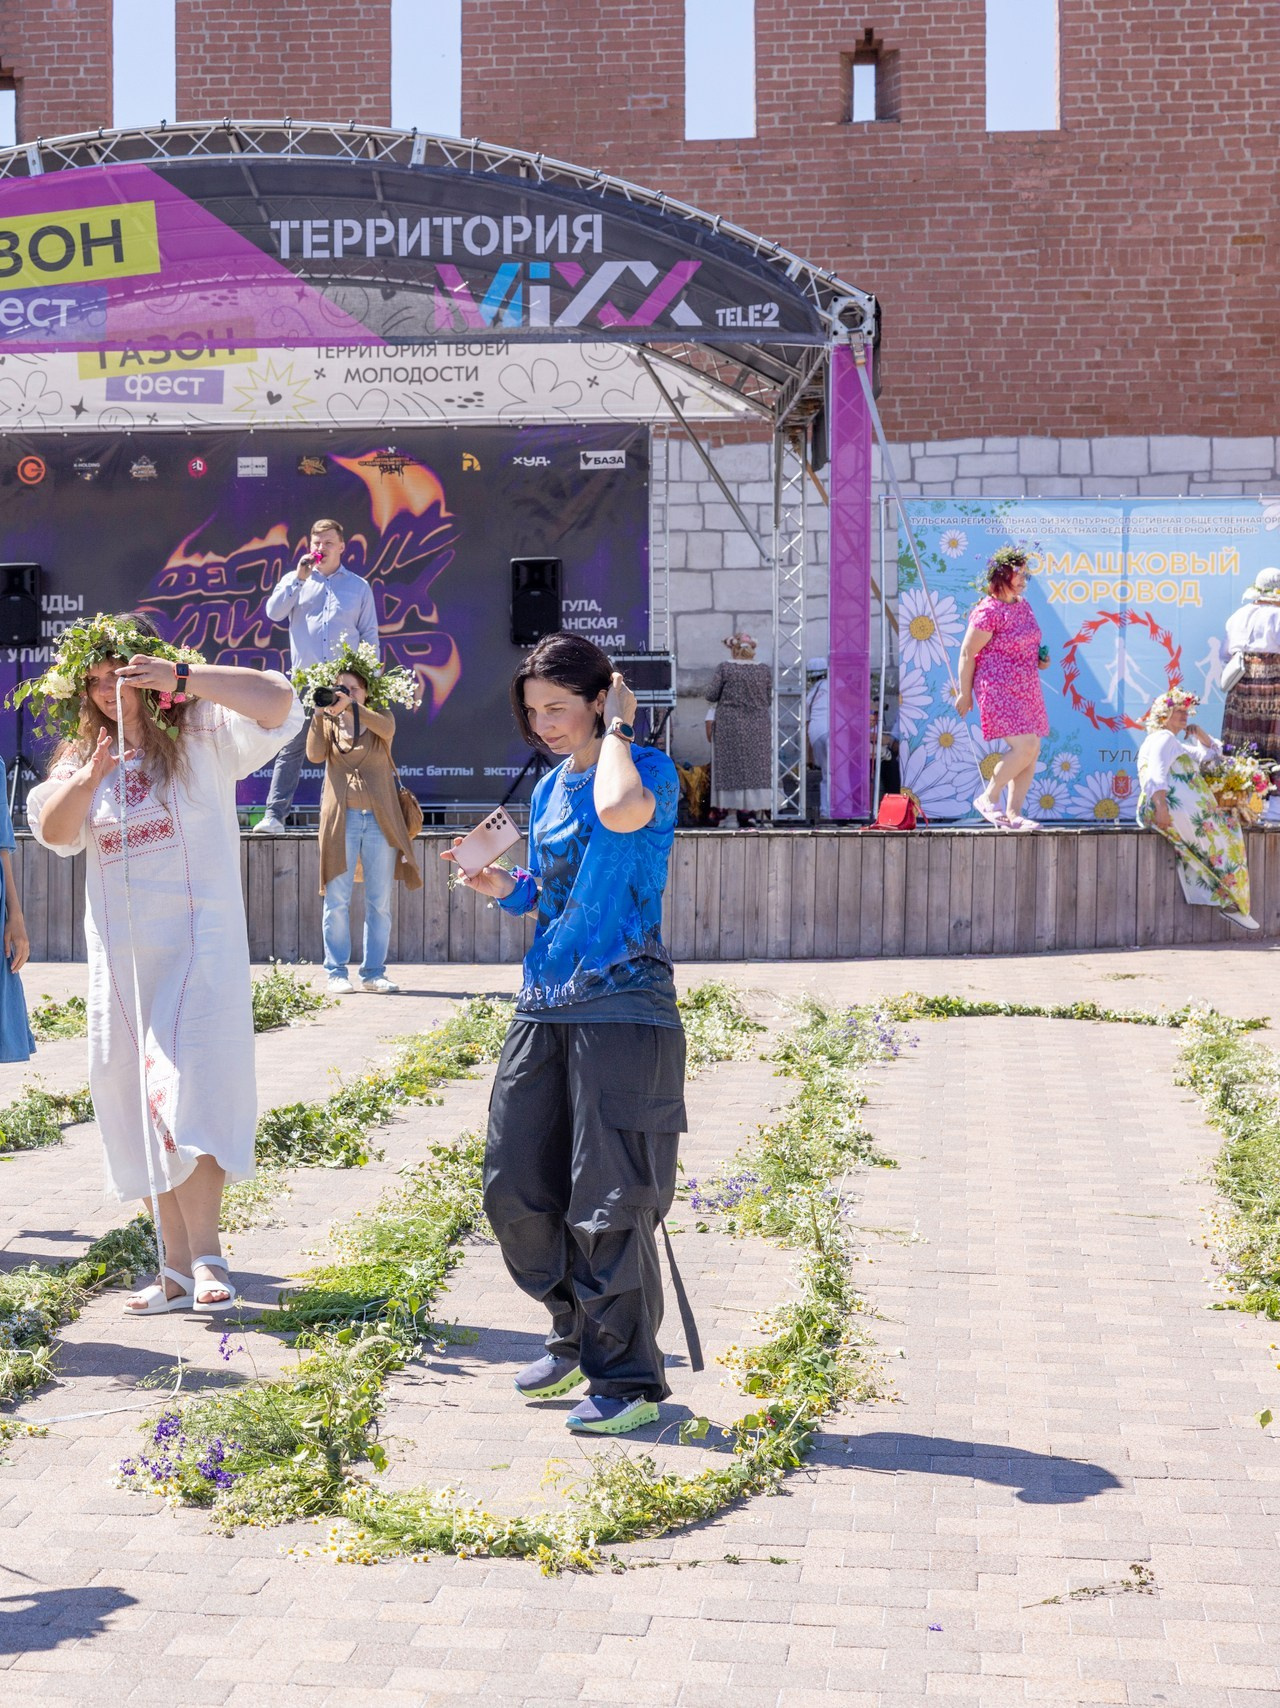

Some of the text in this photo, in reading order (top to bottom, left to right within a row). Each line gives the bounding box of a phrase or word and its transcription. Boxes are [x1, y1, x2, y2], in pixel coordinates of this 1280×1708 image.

[270, 213, 603, 259] ТЕРРИТОРИЯ
[715, 302, 780, 328] TELE2
[317, 343, 438, 359] ТЕРРИТОРИЯ
[343, 366, 479, 385] МОЛОДОСТИ
[124, 374, 206, 401] фест
[593, 456, 625, 465] БАЗА
[911, 517, 959, 525] ТУЛЬСКАЯ
[961, 517, 1037, 525] РЕГИОНАЛЬНАЯ
[1184, 516, 1262, 525] ОБЩЕСТВЕННАЯ
[1041, 527, 1098, 535] ОБЛАСТНАЯ
[1100, 526, 1158, 535] ФЕДЕРАЦИЯ
[1161, 525, 1211, 534] СЕВЕРНОЙ
[1026, 547, 1240, 575] ОМАШКОВЫЙ
[1047, 580, 1203, 607] ХОРОВОД
[426, 765, 474, 776] баттлы
